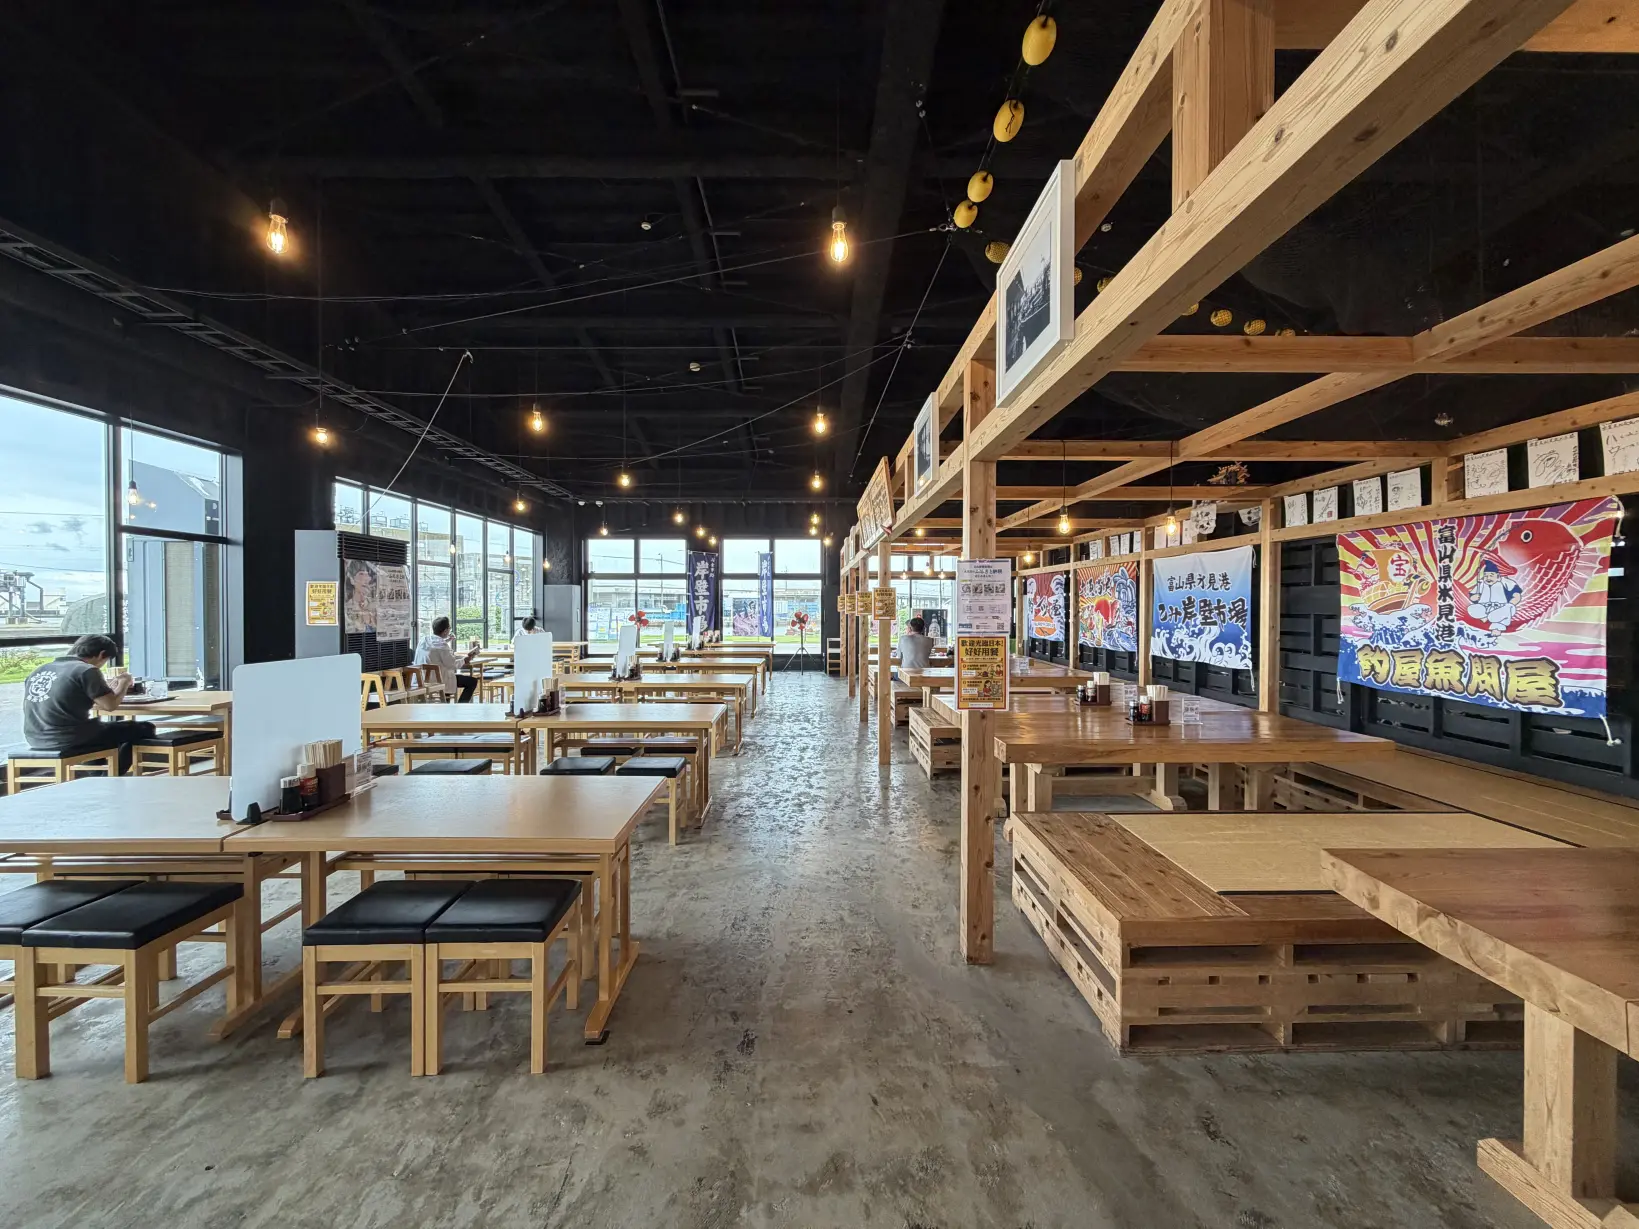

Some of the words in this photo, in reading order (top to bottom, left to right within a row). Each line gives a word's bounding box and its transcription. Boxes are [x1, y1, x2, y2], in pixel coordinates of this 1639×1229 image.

[1389, 554, 1410, 577] 宝
[1167, 571, 1232, 592] 富山県氷見港
[965, 647, 999, 657] 好好用餐
